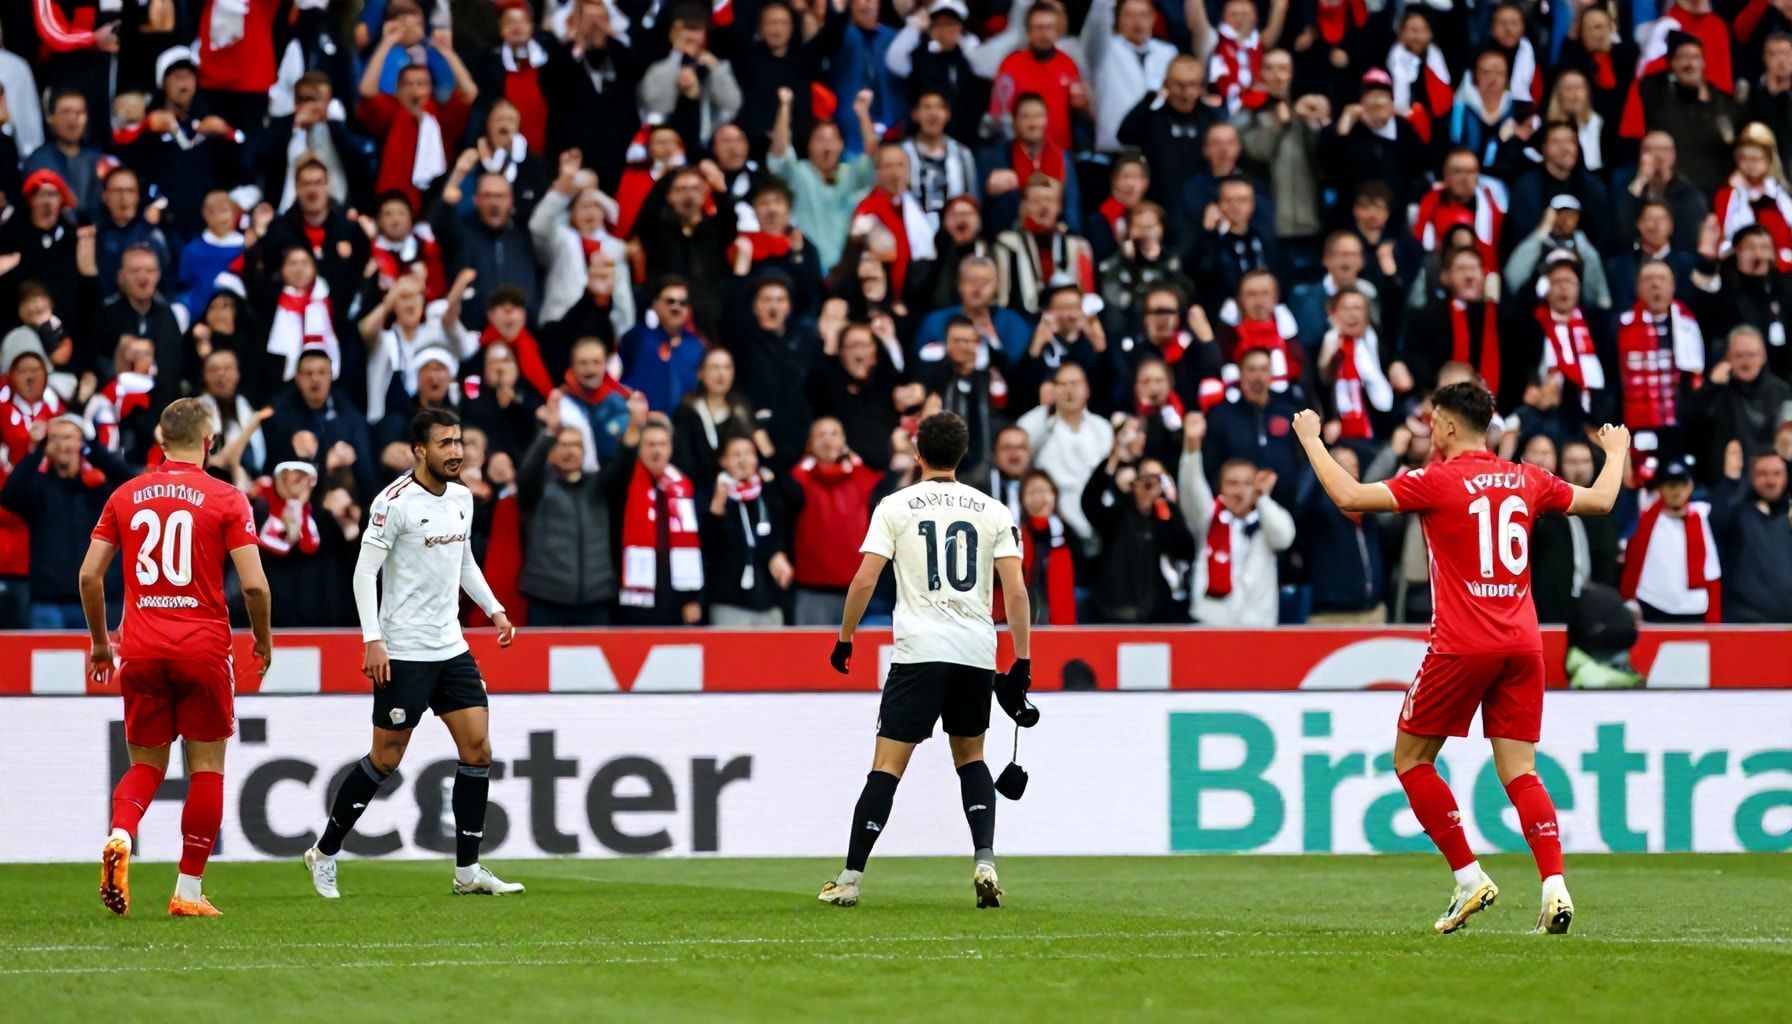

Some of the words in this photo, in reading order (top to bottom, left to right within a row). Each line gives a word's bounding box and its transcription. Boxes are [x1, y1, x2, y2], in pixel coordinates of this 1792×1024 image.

[130, 508, 194, 587] 30
[918, 520, 979, 592] 10
[1468, 495, 1529, 579] 16
